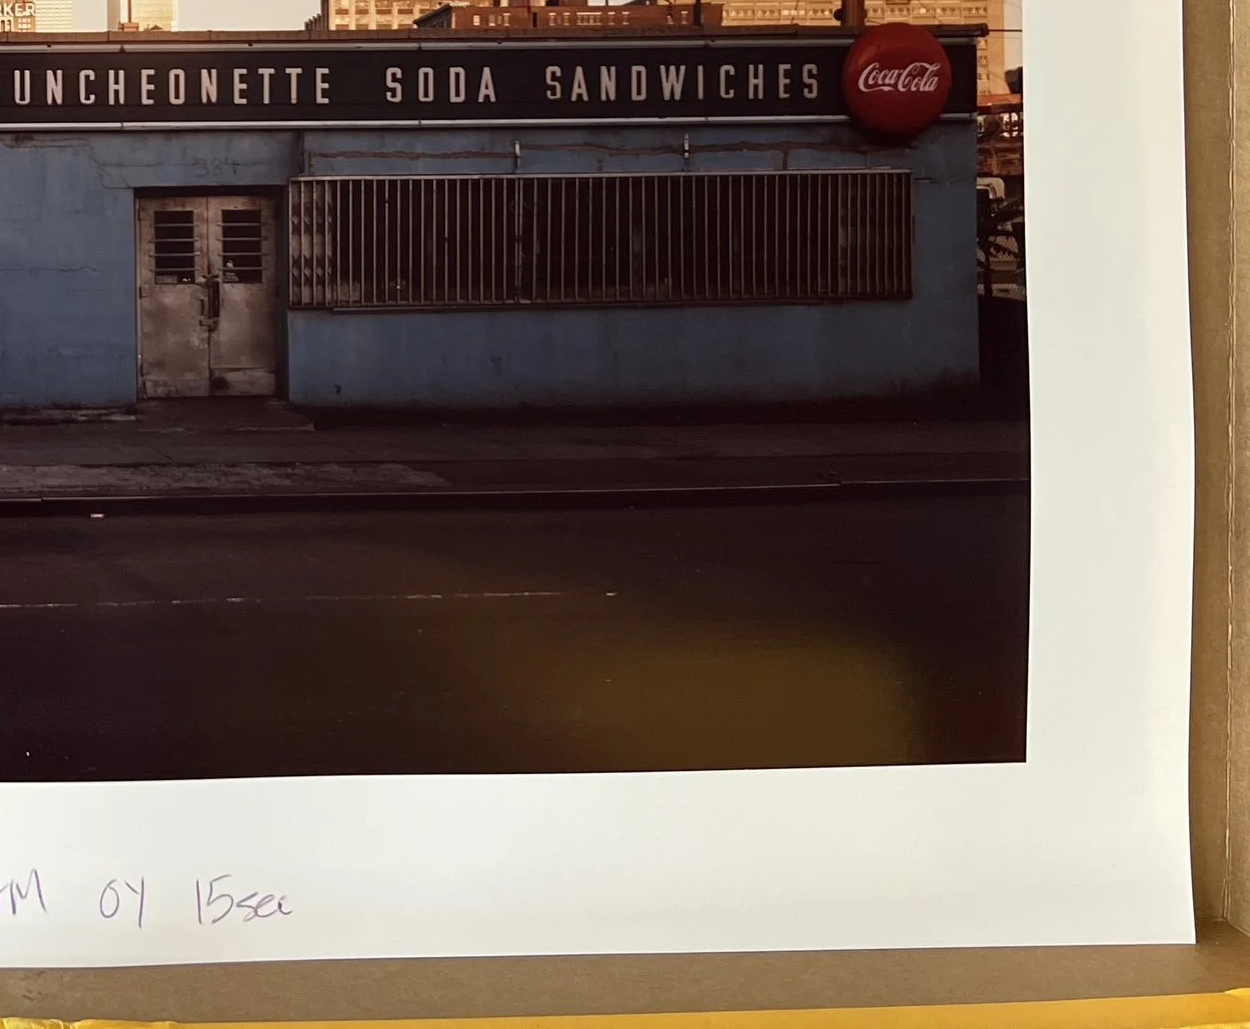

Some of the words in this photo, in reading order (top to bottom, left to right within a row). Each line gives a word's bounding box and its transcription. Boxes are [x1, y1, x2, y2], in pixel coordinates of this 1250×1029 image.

[384, 66, 497, 103] SODA
[545, 63, 819, 102] SANDWICHES
[857, 61, 942, 93] Coca-Cola
